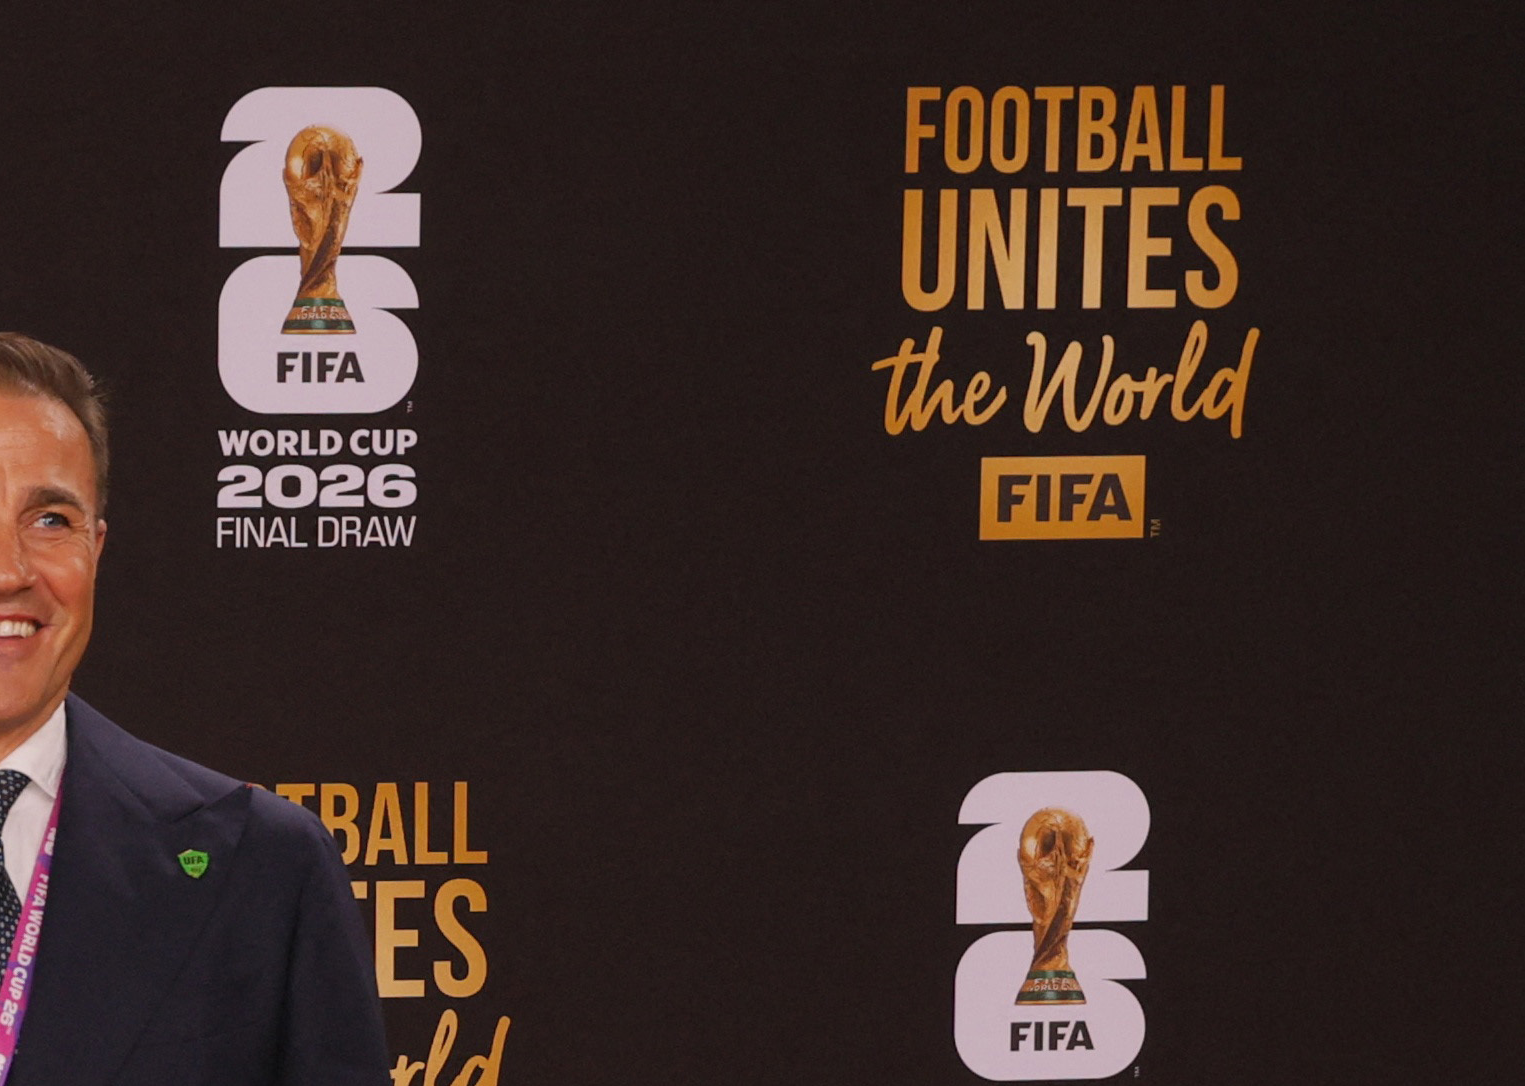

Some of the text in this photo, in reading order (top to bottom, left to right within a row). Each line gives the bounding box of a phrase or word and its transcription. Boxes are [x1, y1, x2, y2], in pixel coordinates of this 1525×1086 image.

[905, 85, 1242, 174] FOOTBALL
[902, 185, 1240, 312] UNITES
[277, 352, 364, 382] FIFA
[872, 320, 1260, 439] the World
[218, 429, 417, 457] WORLD CUP
[217, 464, 417, 508] 2026
[996, 473, 1133, 523] FIFA
[216, 516, 416, 548] FINAL DRAW
[246, 782, 488, 866] BALL
[31, 873, 50, 906] FIFA
[16, 904, 45, 966] WORLD
[9, 966, 29, 1000] CUP
[1010, 1021, 1094, 1051] FIFA
